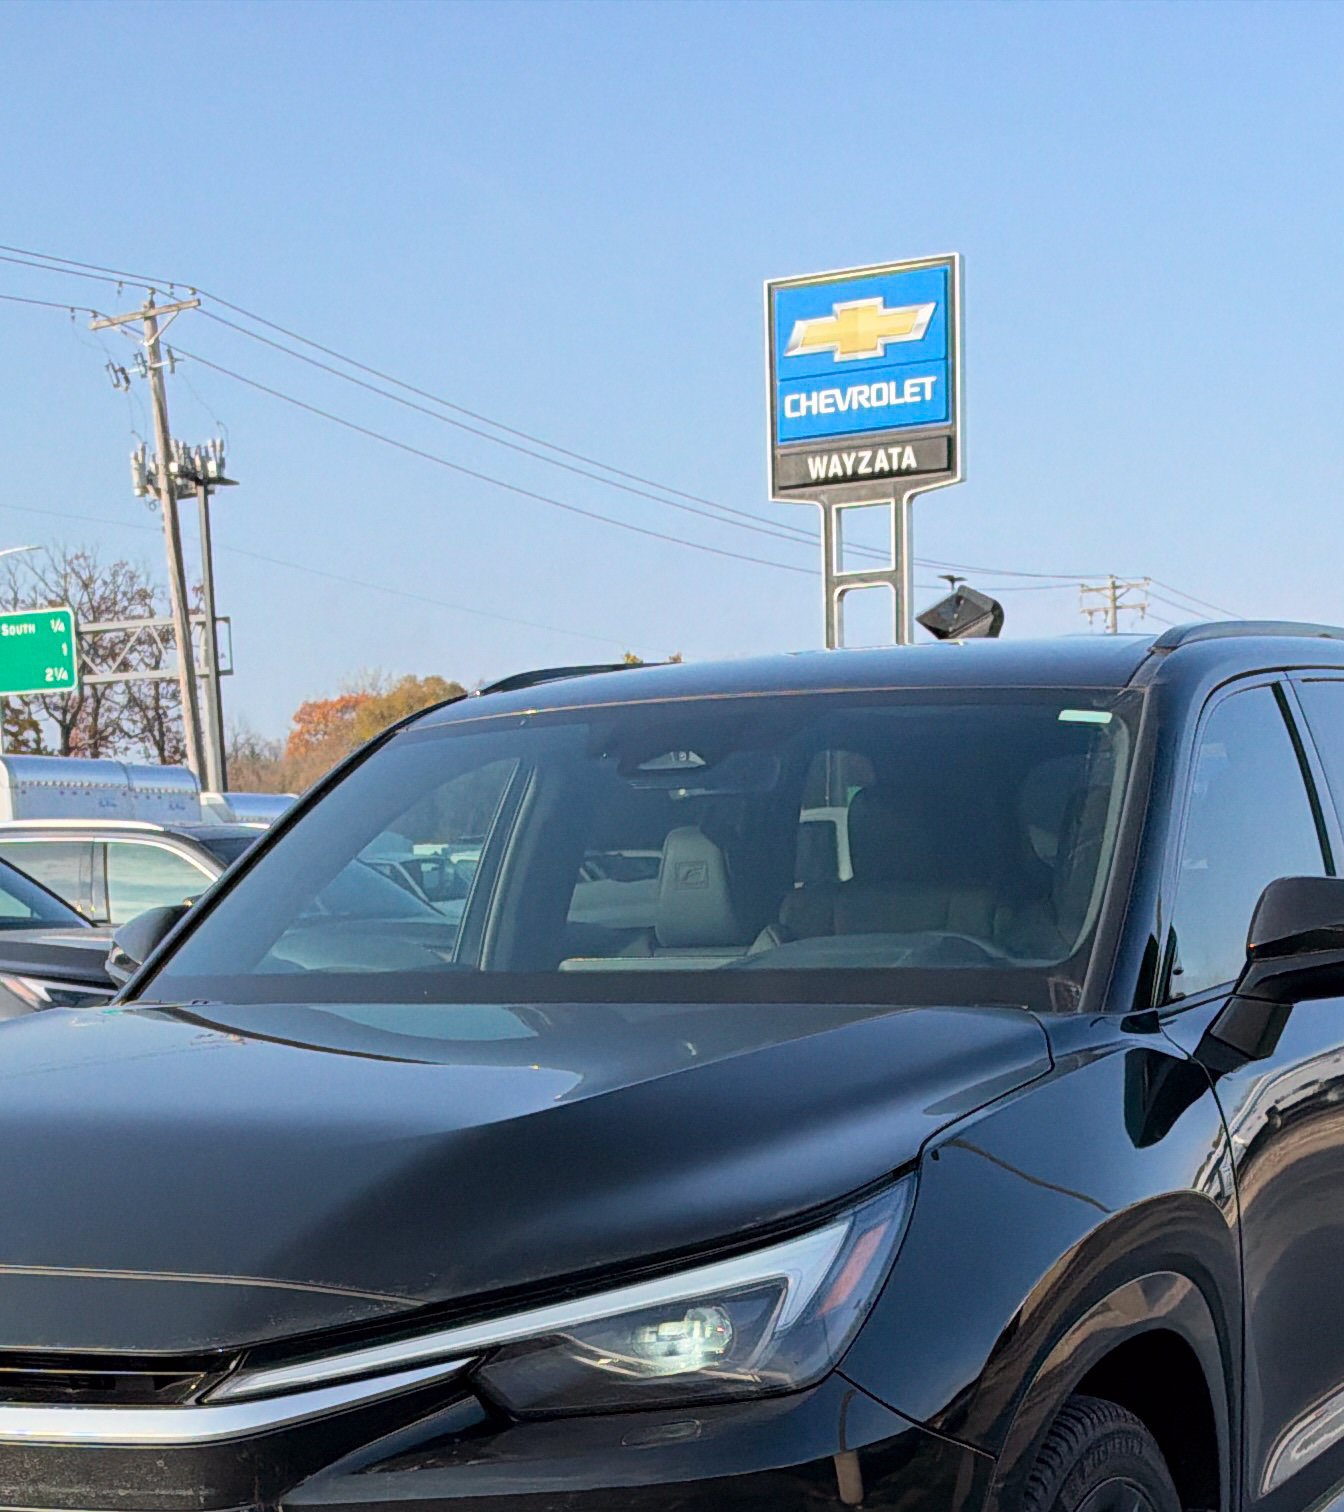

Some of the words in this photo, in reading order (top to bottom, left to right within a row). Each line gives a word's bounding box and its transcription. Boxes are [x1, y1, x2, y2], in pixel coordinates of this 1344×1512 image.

[784, 376, 937, 418] CHEVROLET
[807, 445, 918, 481] WAYZATA
[1, 624, 36, 636] SOUTH
[62, 642, 68, 656] 1
